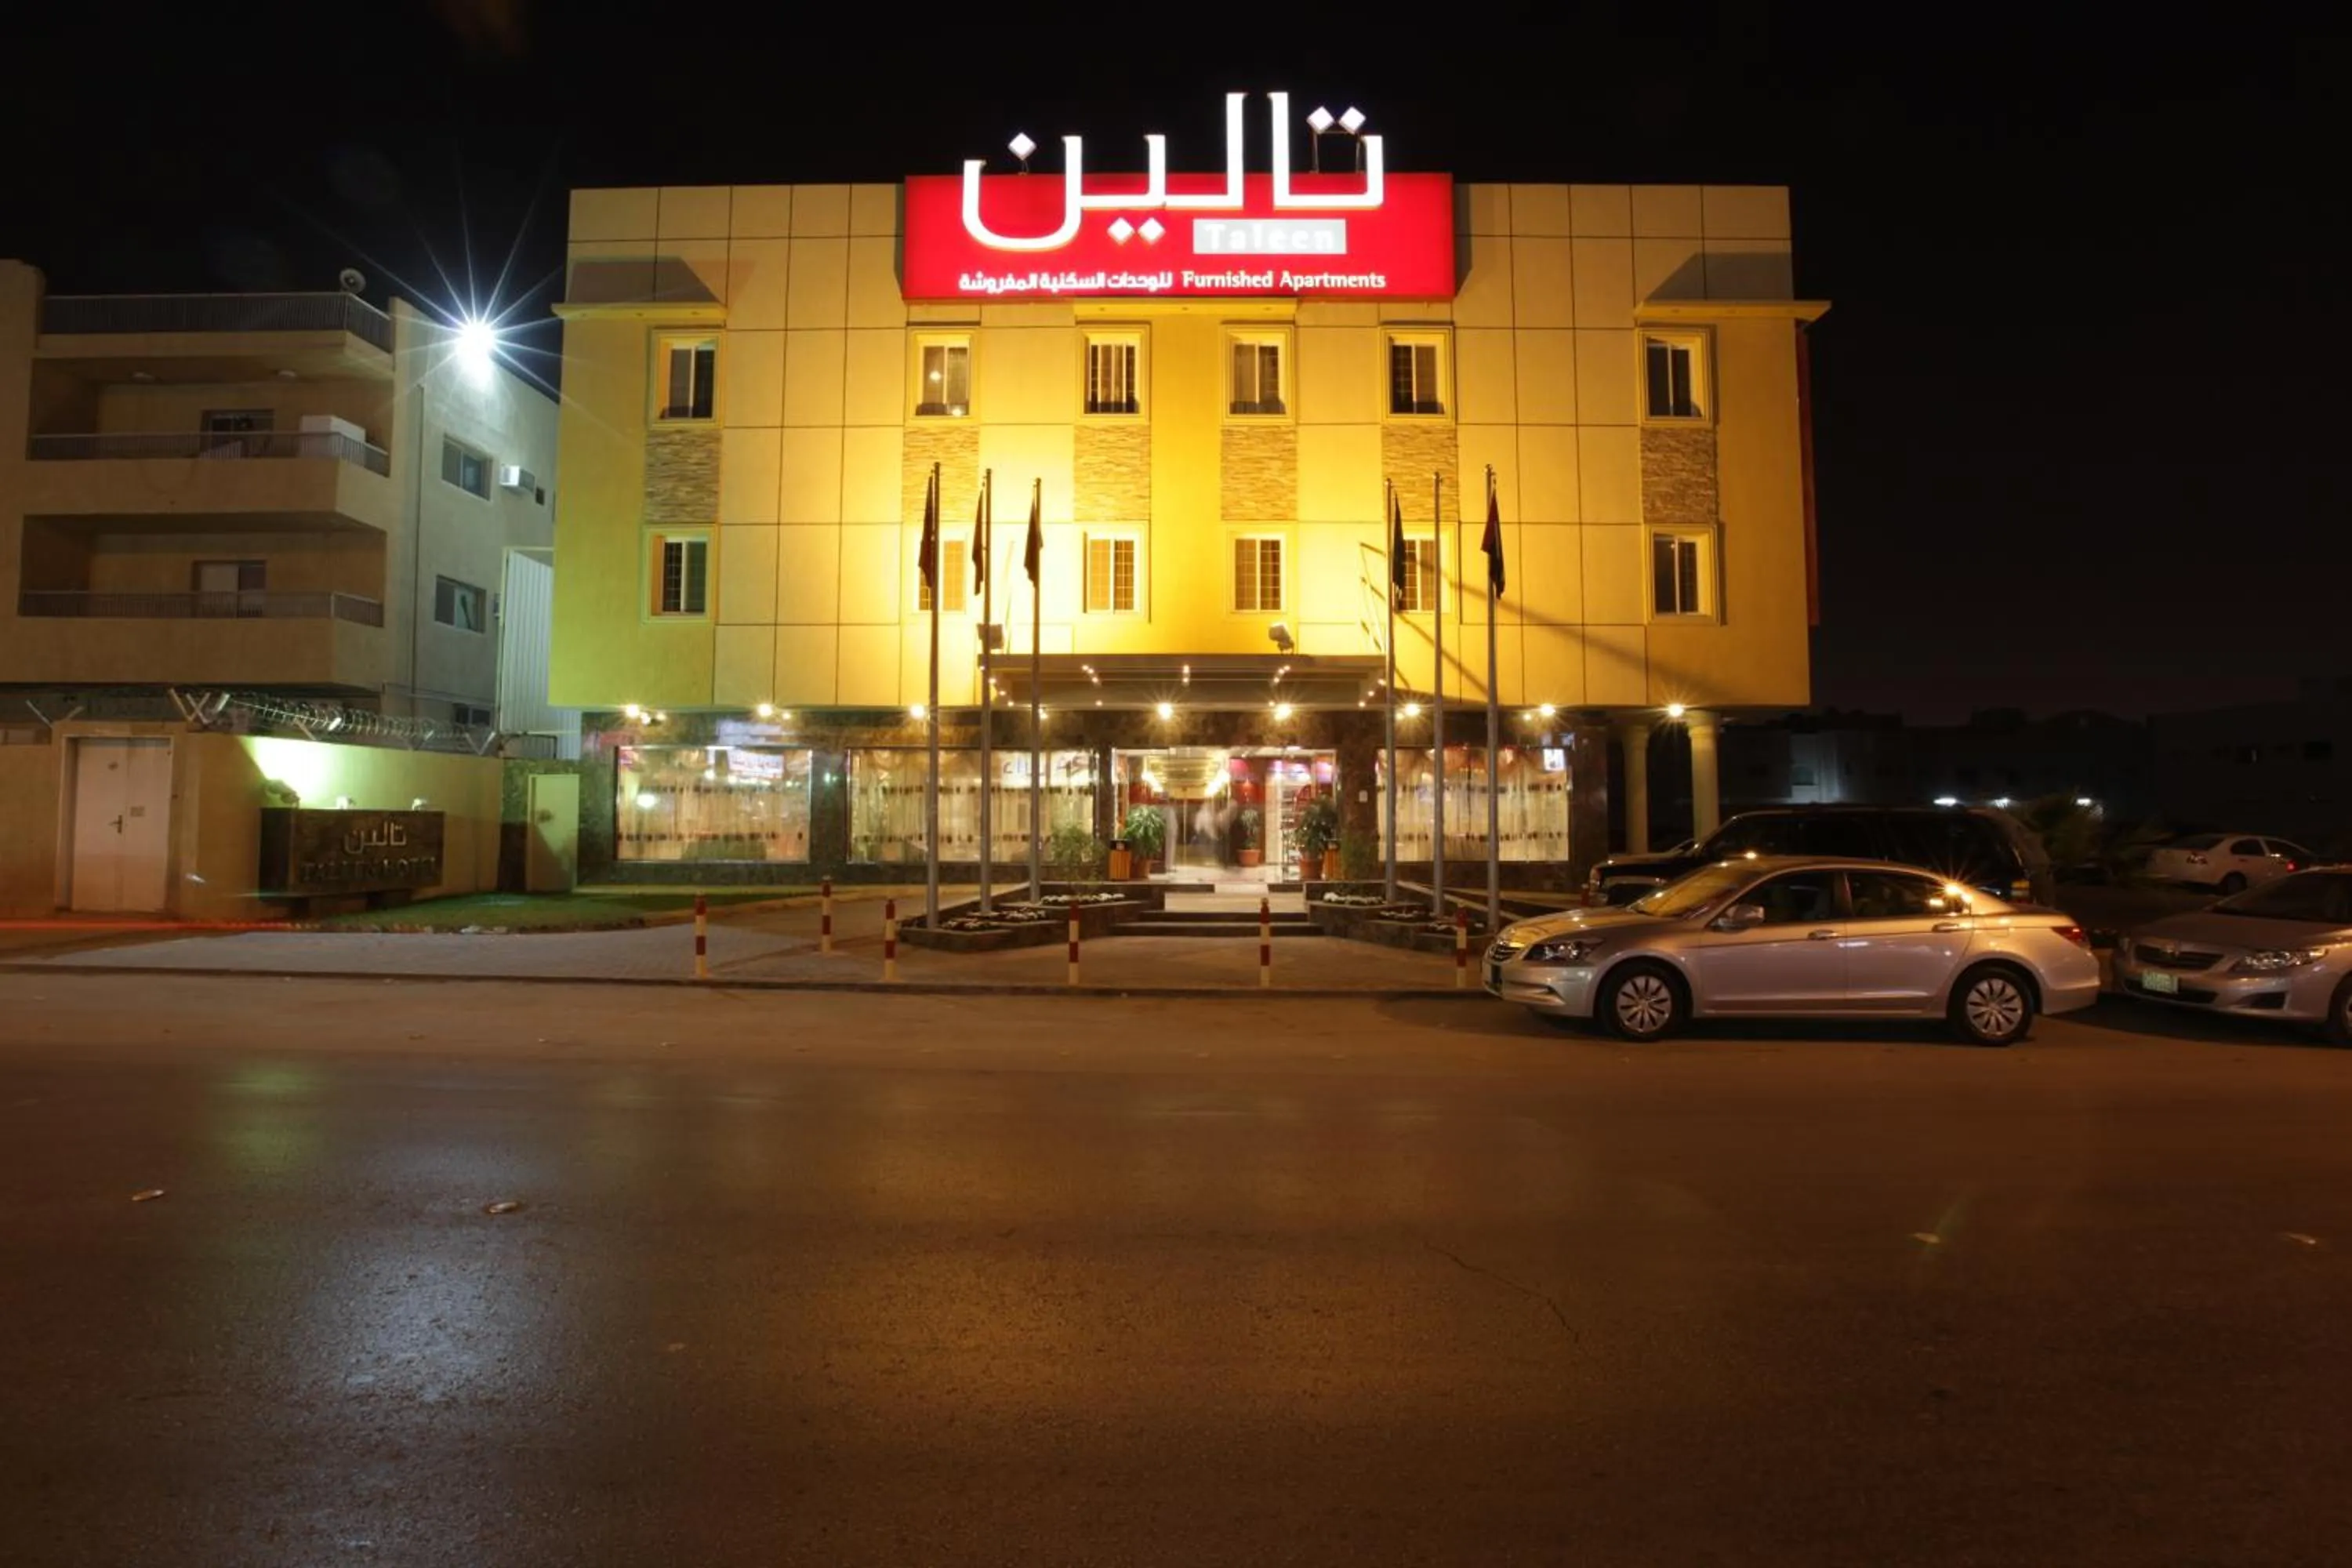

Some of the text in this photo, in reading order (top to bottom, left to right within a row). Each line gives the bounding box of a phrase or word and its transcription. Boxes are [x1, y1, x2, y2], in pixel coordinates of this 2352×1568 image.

[962, 93, 1385, 250] تالين
[1204, 223, 1335, 251] Taleen
[958, 271, 1174, 294] للوحدات السكنية المفروشة
[1181, 270, 1386, 291] Furnished Apartments
